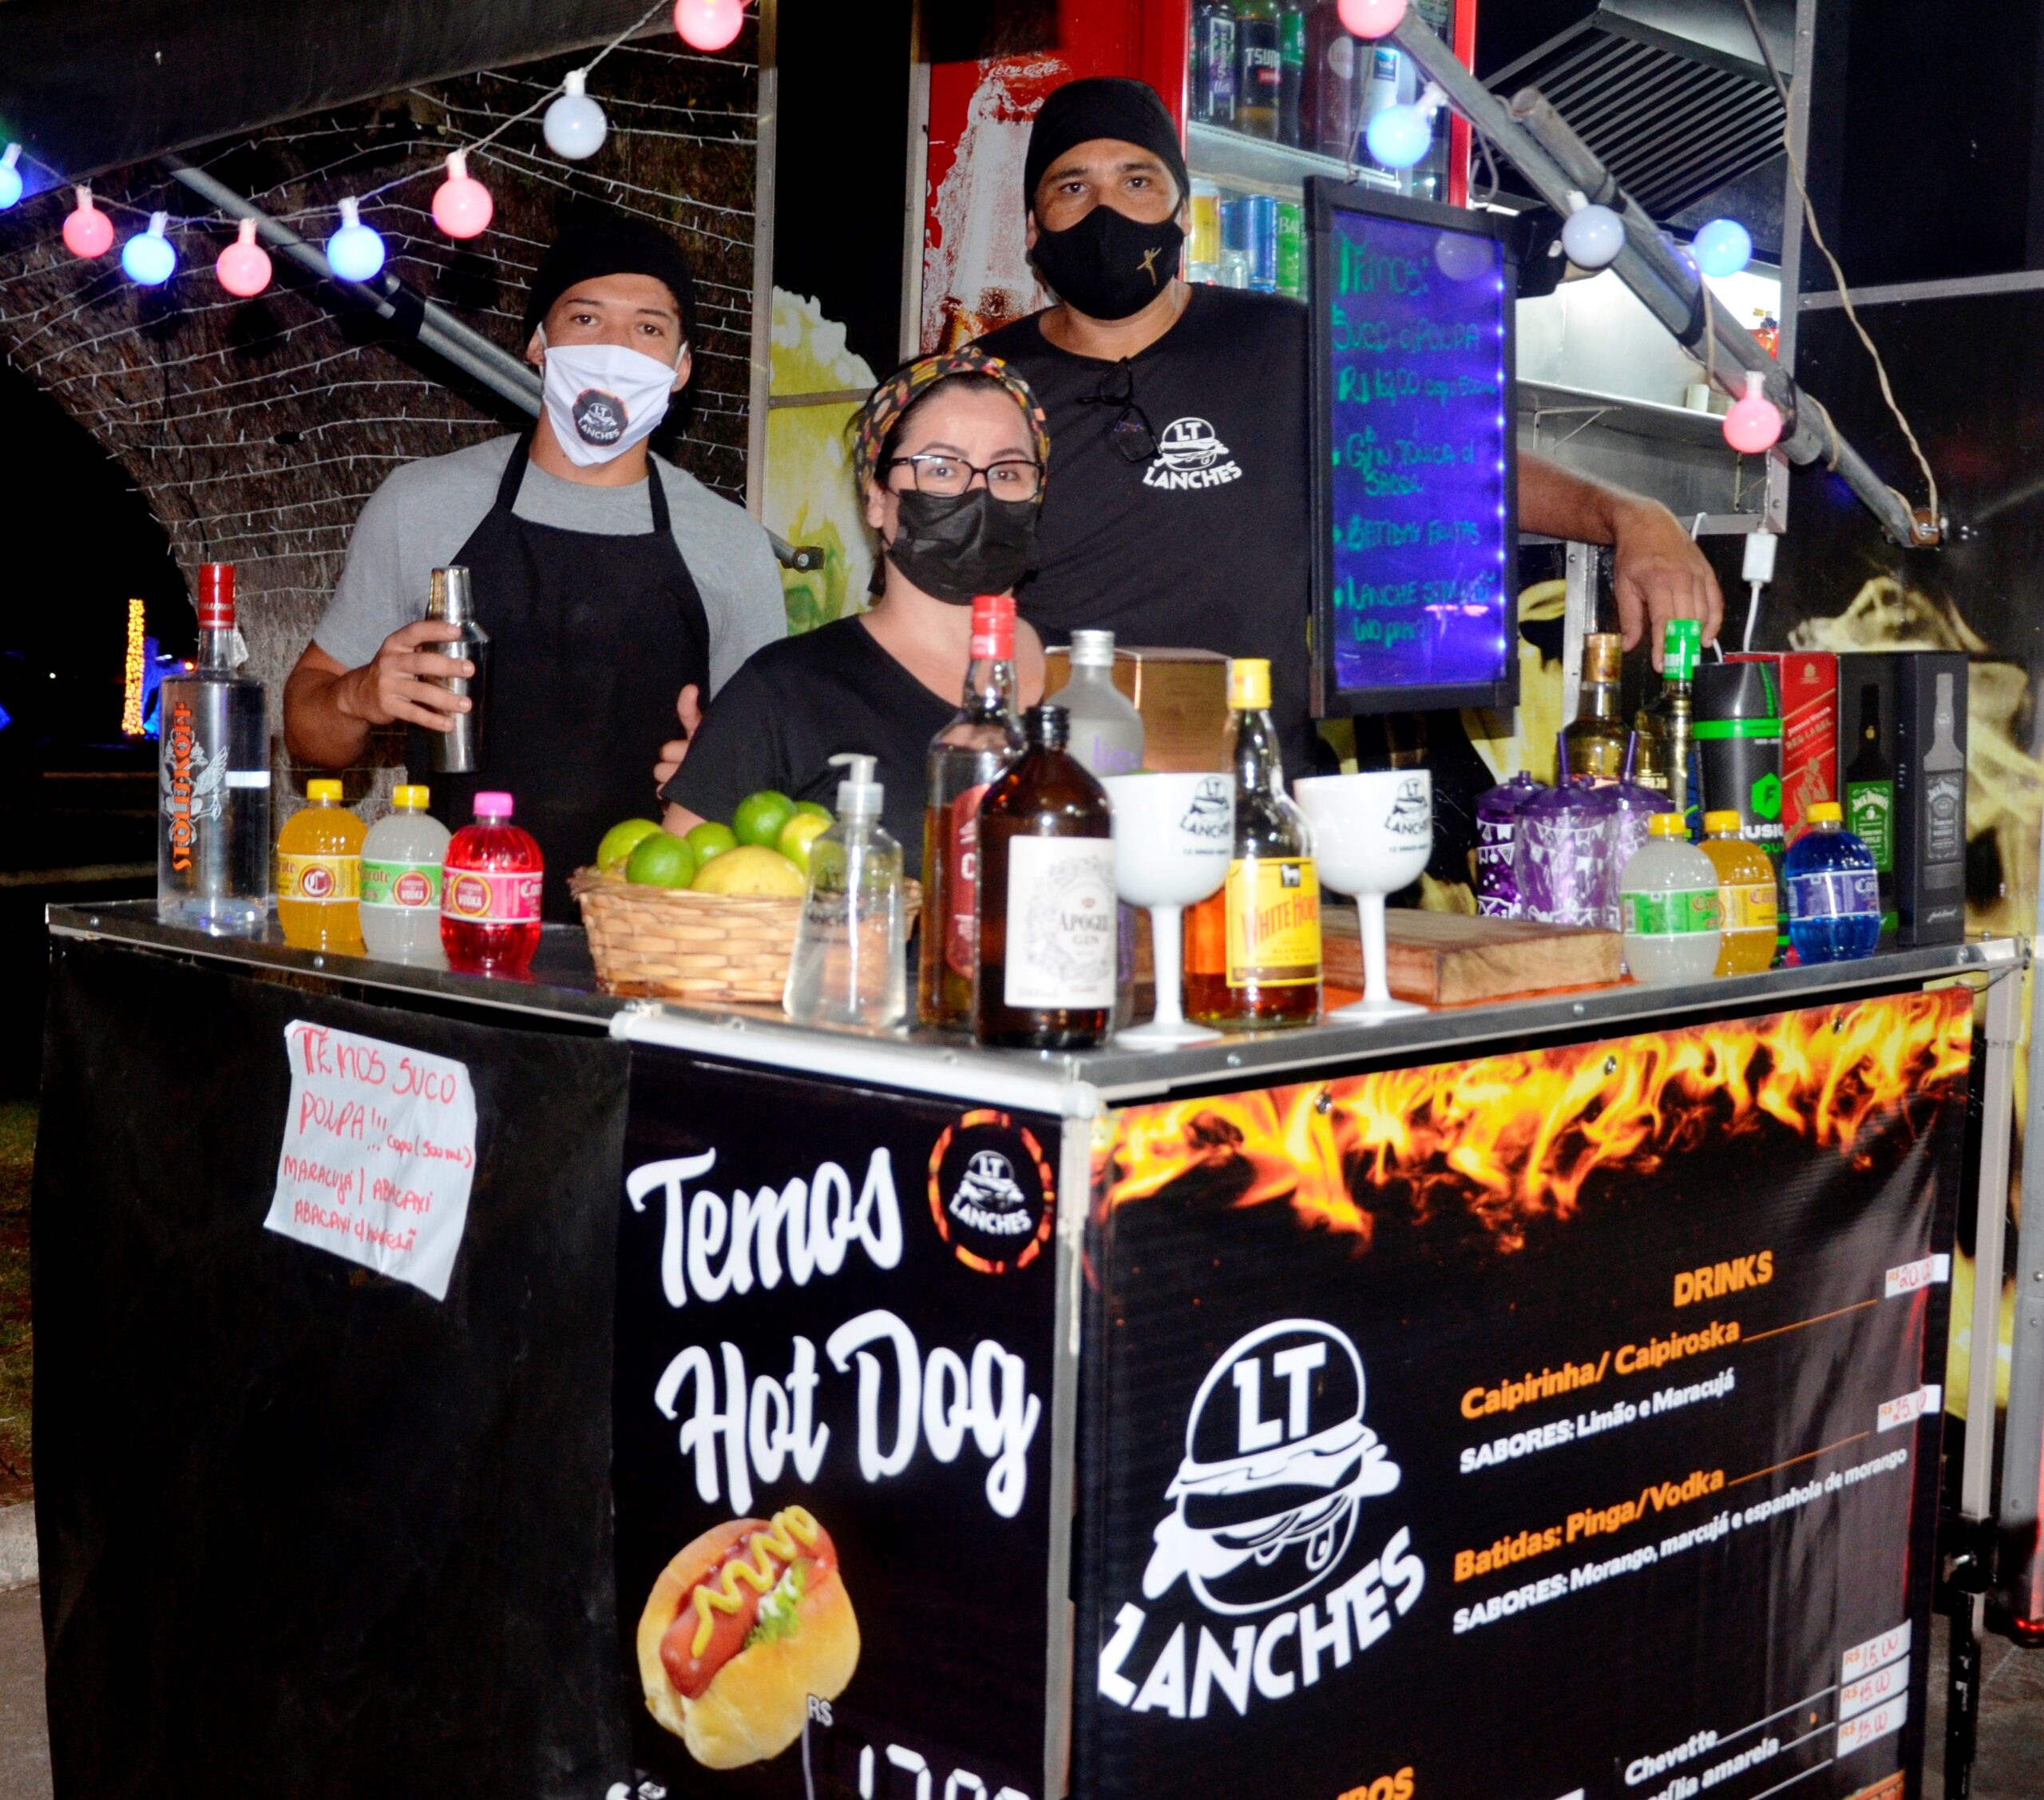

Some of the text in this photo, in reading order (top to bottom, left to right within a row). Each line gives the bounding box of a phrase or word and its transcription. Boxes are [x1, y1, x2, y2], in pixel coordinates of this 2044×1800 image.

[594, 405, 608, 417] LT
[1174, 422, 1202, 441] LT
[1142, 460, 1242, 490] LANCHES
[392, 1057, 457, 1104] SUCO
[979, 1156, 1004, 1178] LT
[626, 1147, 904, 1308] Temos
[949, 1193, 1032, 1235] LANCHES
[1673, 1251, 1774, 1308] DRINKS
[1614, 1321, 1741, 1375] Caipiroska
[654, 1309, 1041, 1518] Hot Dog
[1233, 1341, 1326, 1453] LT
[1460, 1367, 1735, 1474] SABORES: Limão e Maracujá
[1452, 1573, 1569, 1635] SABORES:
[1570, 1545, 1658, 1591] Morango,
[1731, 1512, 1743, 1529] e
[1744, 1481, 1823, 1525] espanhola
[1824, 1471, 1844, 1493] de
[1844, 1448, 1908, 1485] morango
[1454, 1525, 1563, 1583] Batidas:
[1098, 1525, 1426, 1719] LANCHES
[1625, 1730, 1718, 1786] Chevette
[1701, 1737, 1780, 1789] amarela
